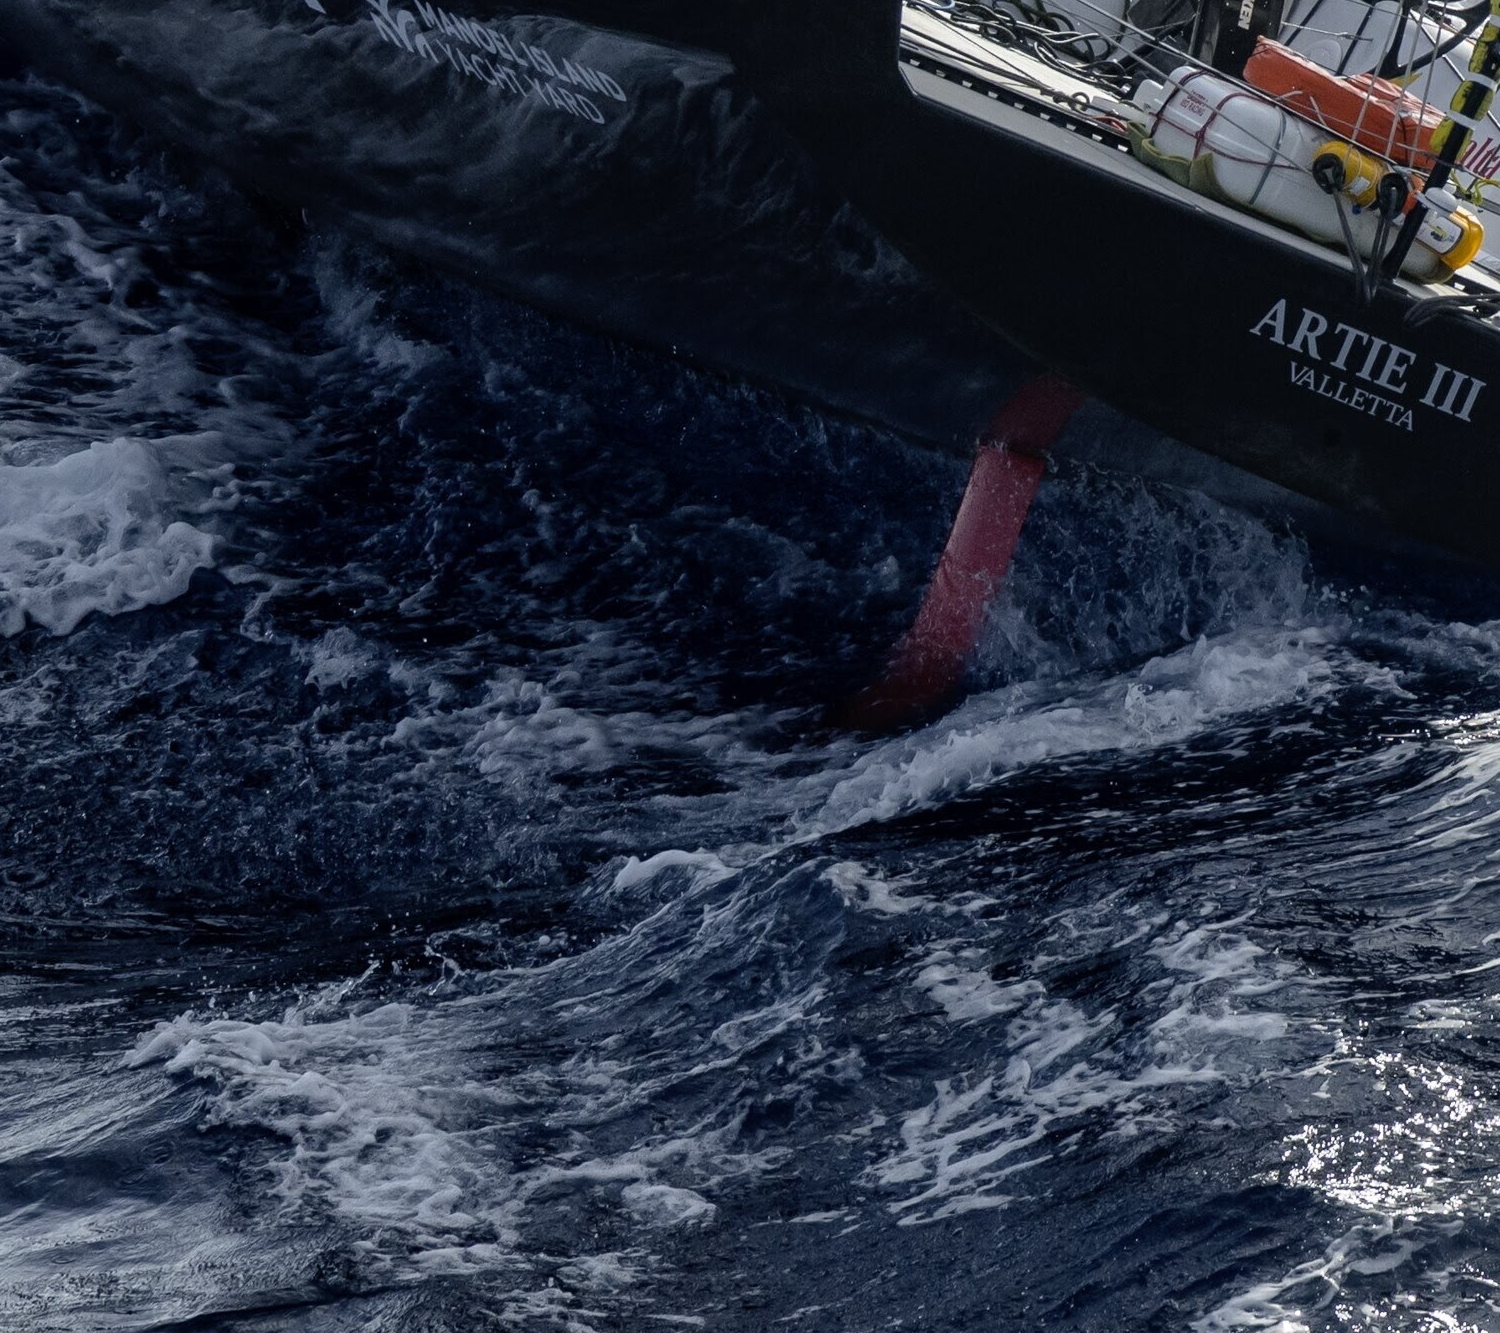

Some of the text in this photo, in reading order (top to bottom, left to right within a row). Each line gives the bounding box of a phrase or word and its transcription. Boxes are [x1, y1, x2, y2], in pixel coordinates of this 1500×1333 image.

[436, 39, 605, 124] YACHT YARD
[520, 41, 626, 102] ISLAND
[1249, 298, 1487, 422] ARTIE III
[1290, 361, 1414, 432] VALLETTA
